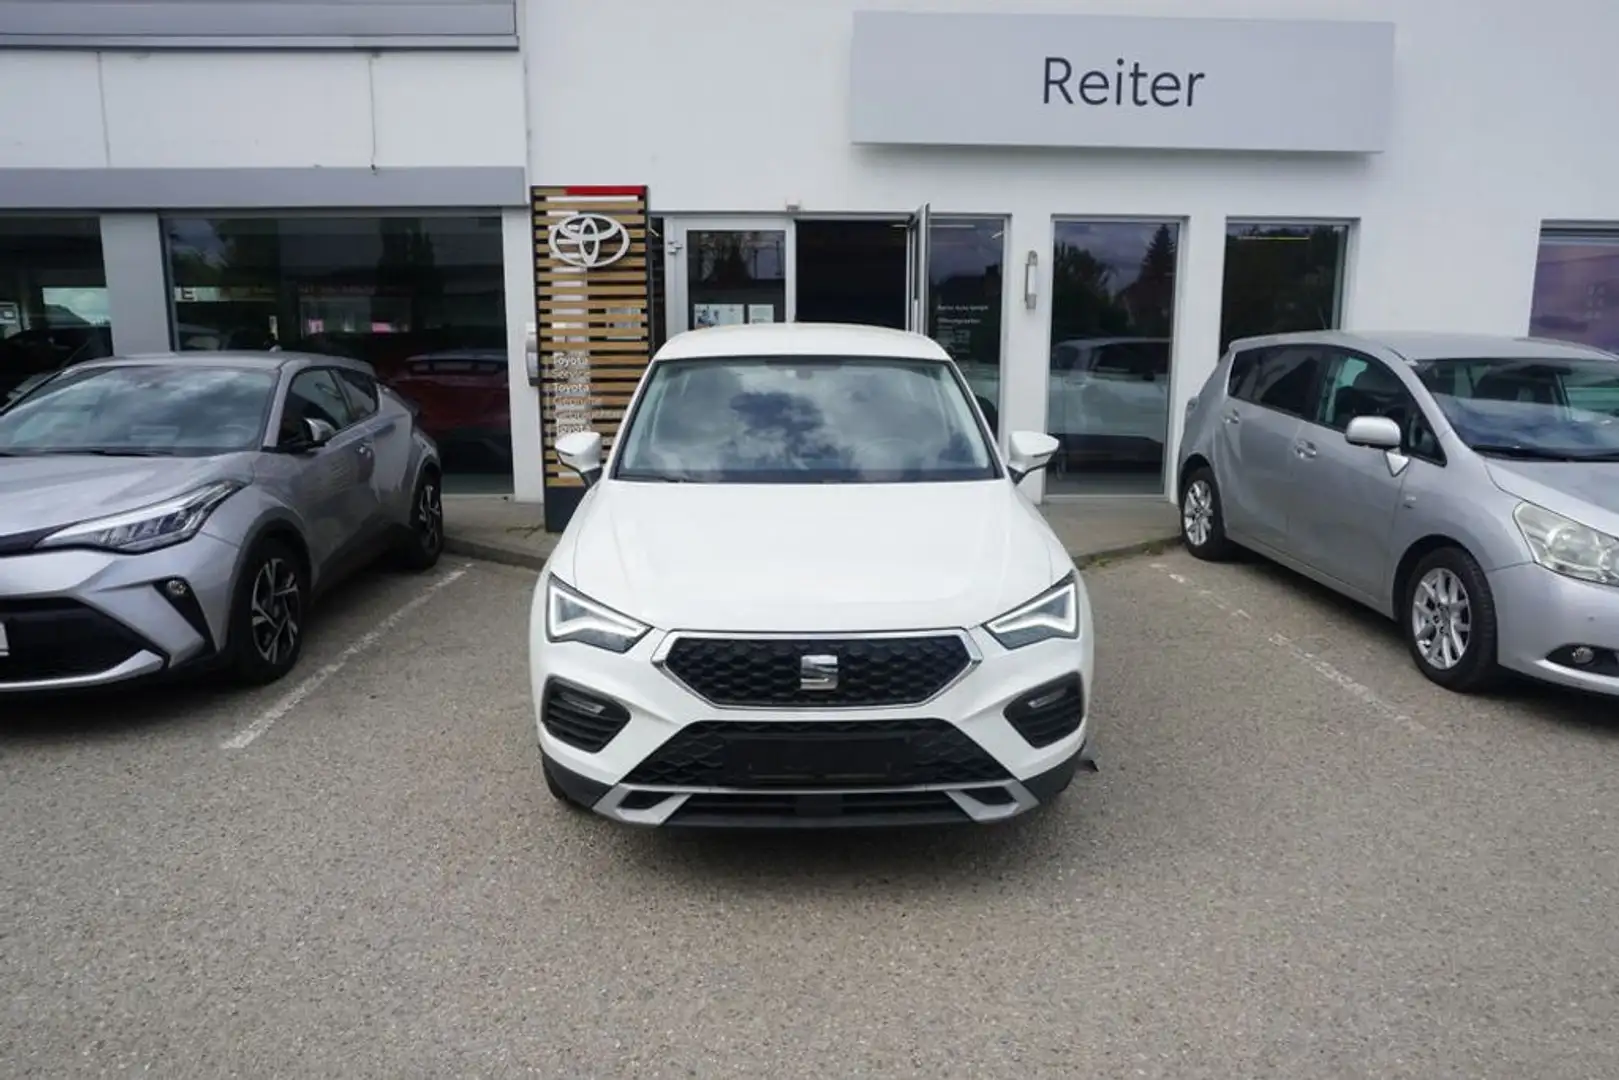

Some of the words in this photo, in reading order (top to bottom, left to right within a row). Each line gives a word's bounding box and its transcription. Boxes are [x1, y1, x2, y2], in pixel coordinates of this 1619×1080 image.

[1043, 56, 1206, 107] Reiter
[553, 352, 588, 367] Toyota
[552, 382, 590, 394] Toyota
